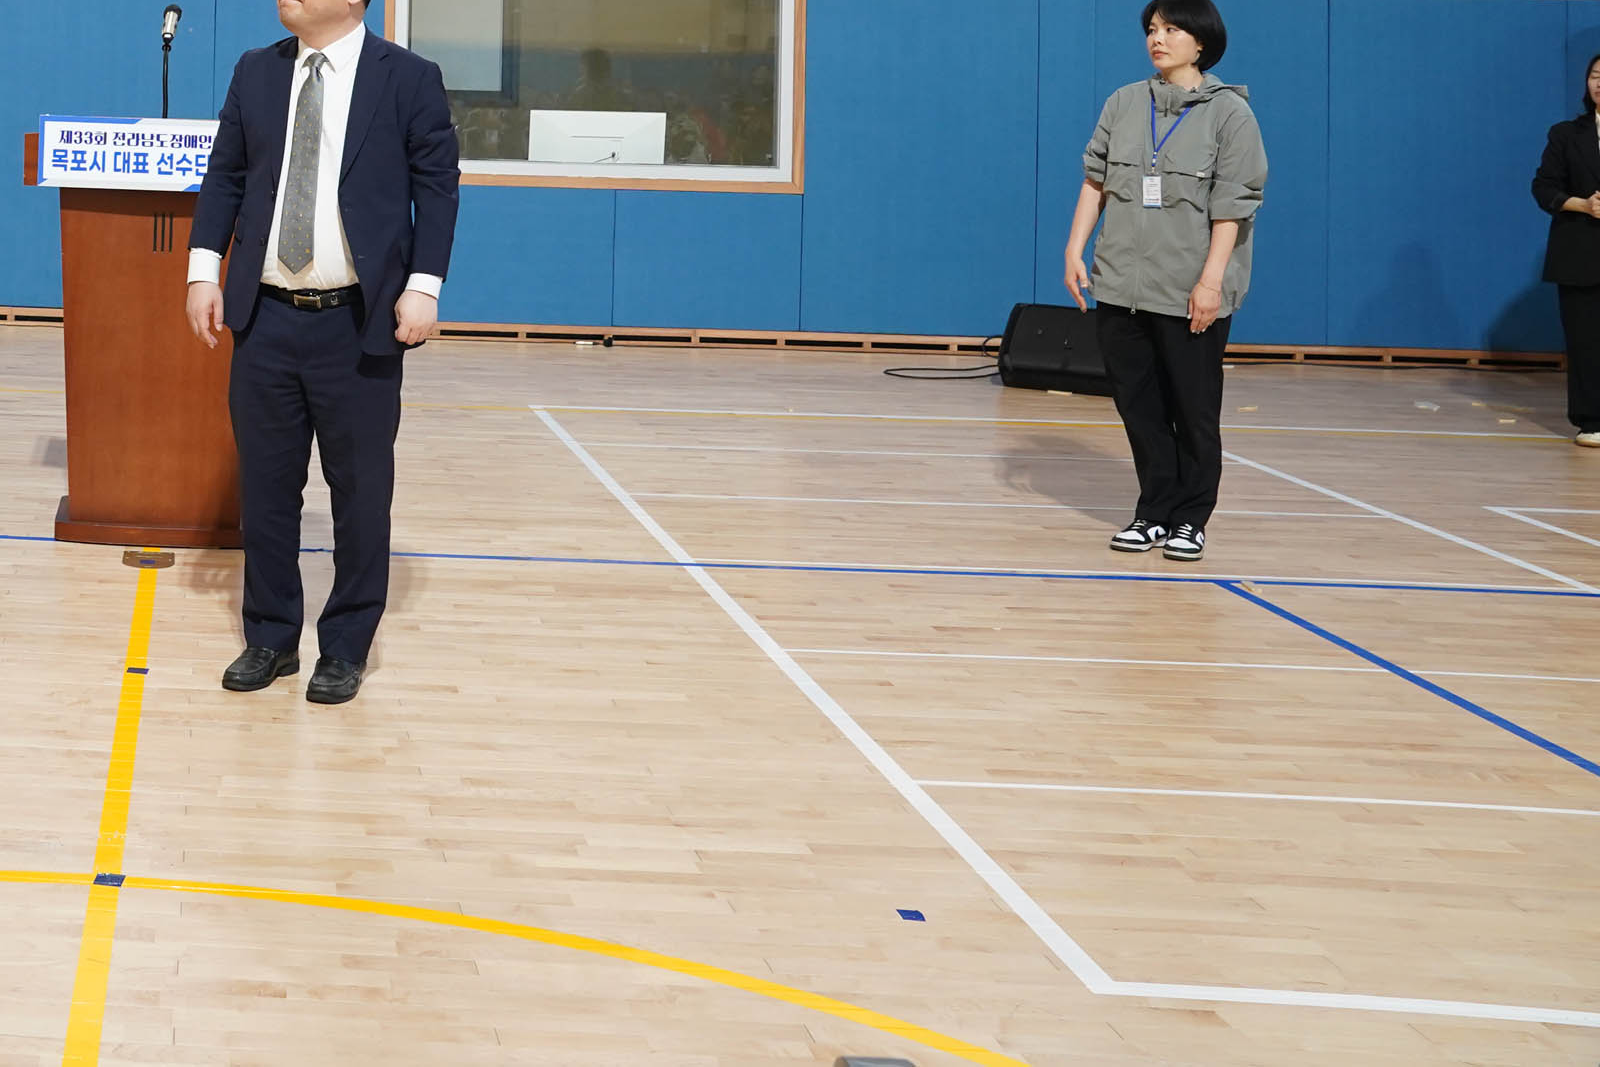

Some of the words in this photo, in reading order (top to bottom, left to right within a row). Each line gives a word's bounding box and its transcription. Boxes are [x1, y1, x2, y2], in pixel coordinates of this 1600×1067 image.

[58, 129, 108, 146] 제33회
[112, 131, 212, 150] 전라남도장애인
[51, 149, 106, 173] 목포시
[113, 151, 150, 174] 대표
